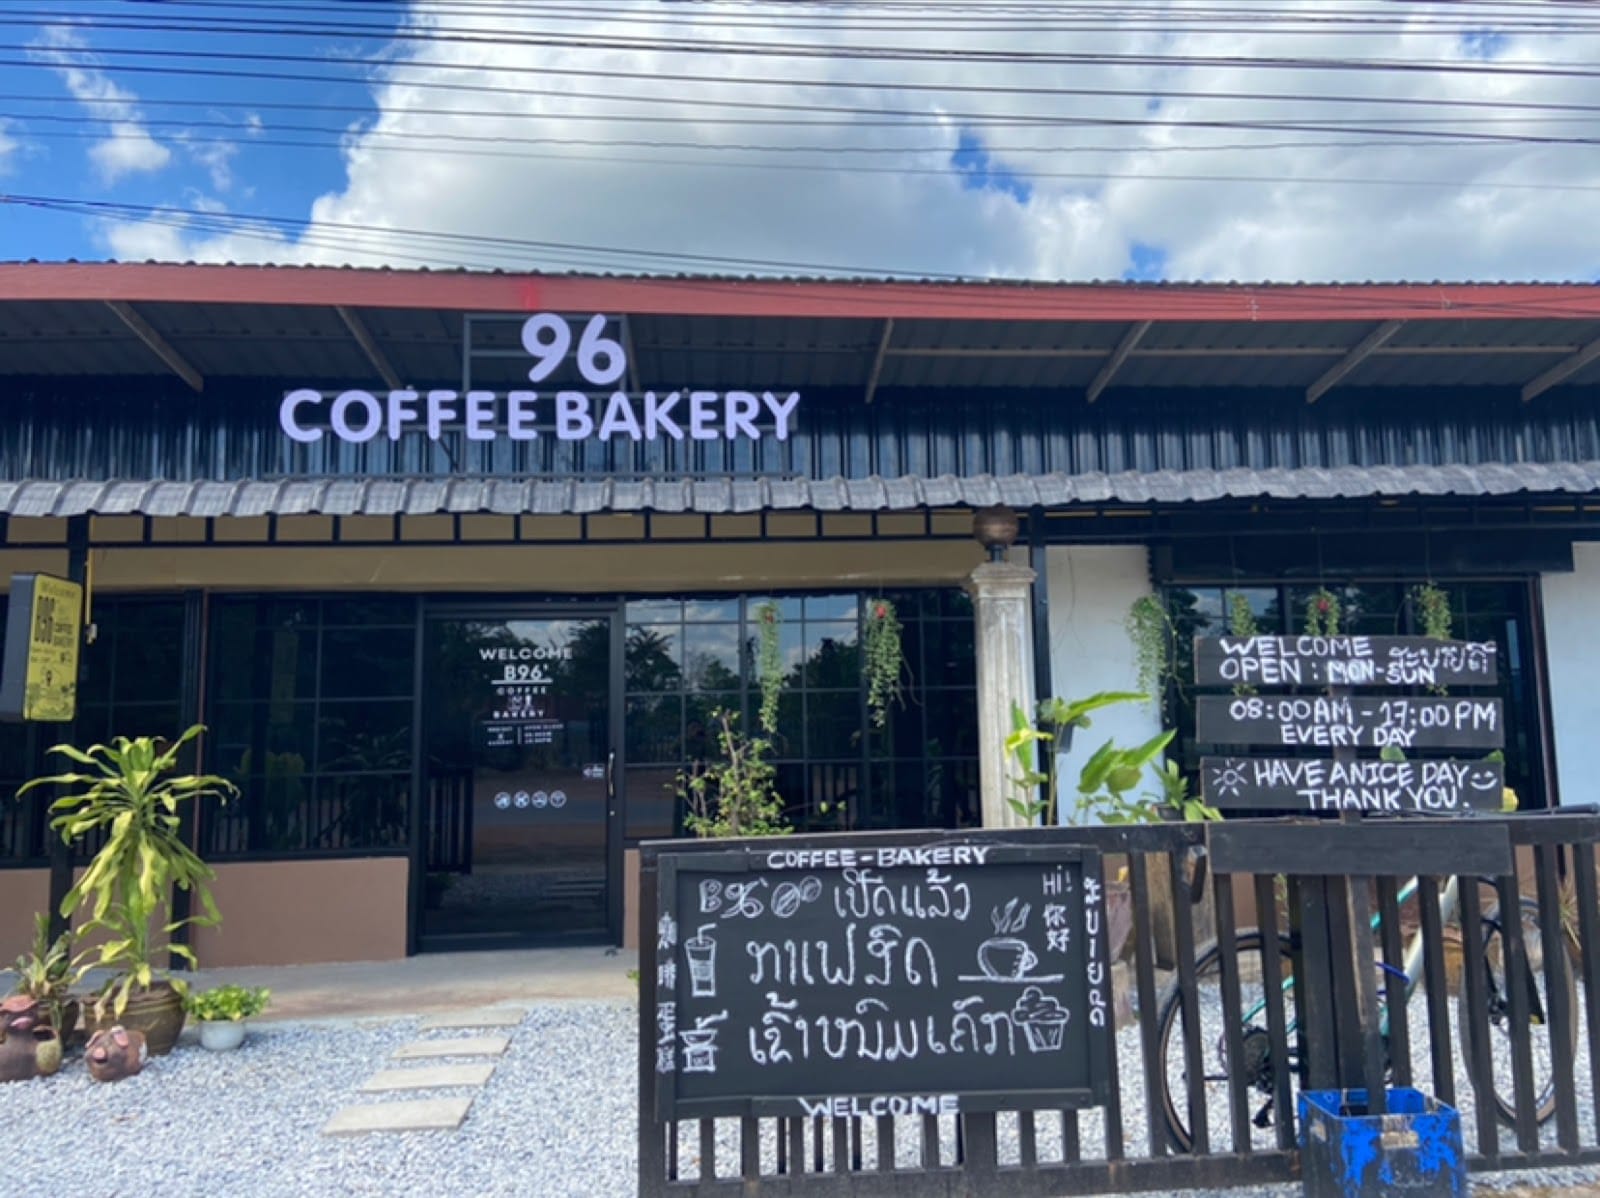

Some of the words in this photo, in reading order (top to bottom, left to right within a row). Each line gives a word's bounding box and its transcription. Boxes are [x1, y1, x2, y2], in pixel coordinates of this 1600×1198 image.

[520, 312, 627, 385] 96
[279, 389, 538, 443] COFFEE
[555, 391, 801, 441] BAKERY
[480, 648, 573, 660] WELCOME
[1218, 636, 1373, 657] WELCOME
[1219, 657, 1302, 685] OPEN
[1280, 724, 1365, 745] EVERY
[1373, 727, 1418, 747] DAY
[1253, 759, 1326, 787] HAVE
[1422, 761, 1470, 789] DAY
[1296, 788, 1401, 811] THANK
[1042, 864, 1073, 895] Hi!
[1042, 902, 1071, 953] 你好
[798, 1096, 960, 1118] WELCOME
